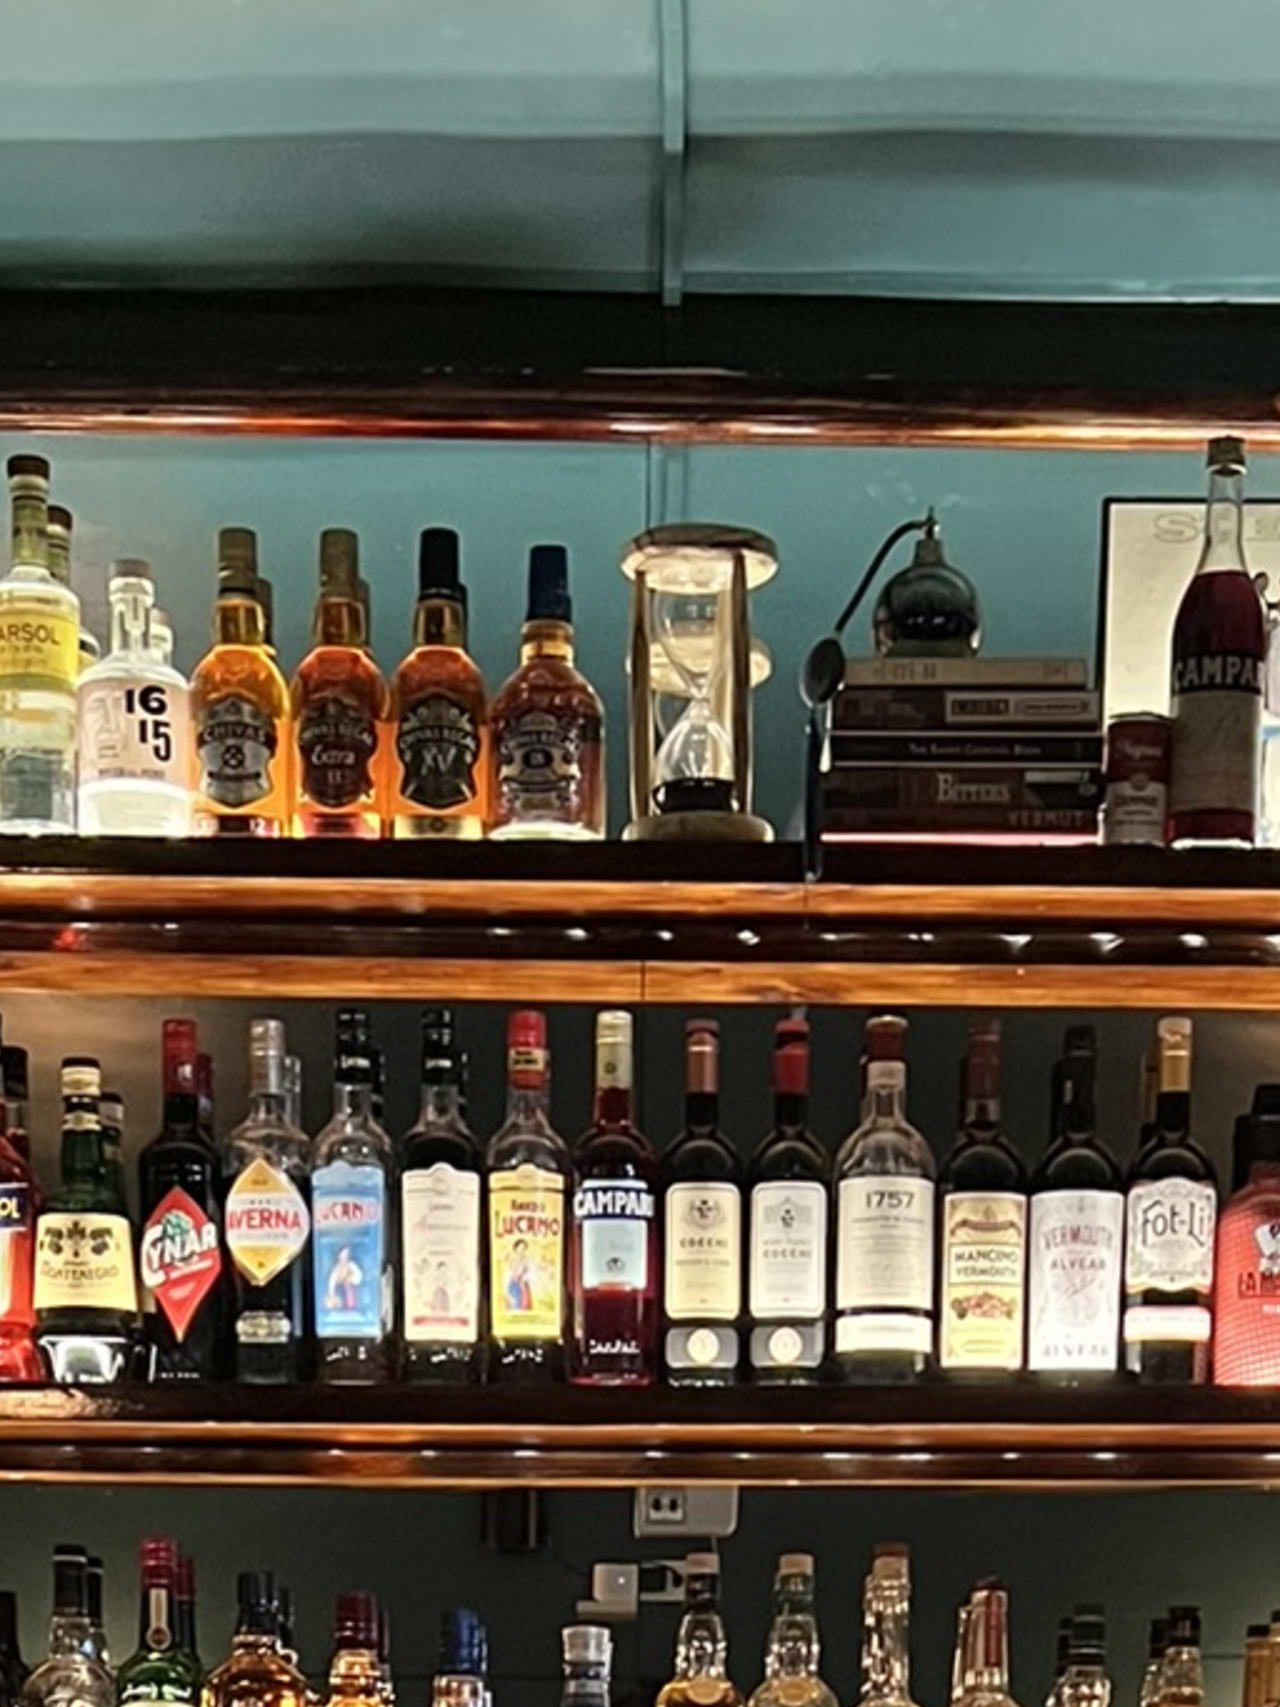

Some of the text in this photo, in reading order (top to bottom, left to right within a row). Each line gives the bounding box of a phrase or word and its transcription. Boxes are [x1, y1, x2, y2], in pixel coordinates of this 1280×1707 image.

[125, 684, 168, 715] 16
[139, 719, 171, 762] 15
[203, 724, 267, 744] CHIVAS
[421, 747, 456, 776] XV
[865, 1191, 916, 1210] 1757
[227, 1207, 303, 1232] AVERNA
[494, 1206, 561, 1239] LUCANO
[1140, 1198, 1207, 1249] Fot-Li
[141, 1221, 218, 1288] CYNAR
[954, 1249, 1019, 1265] MANCINO
